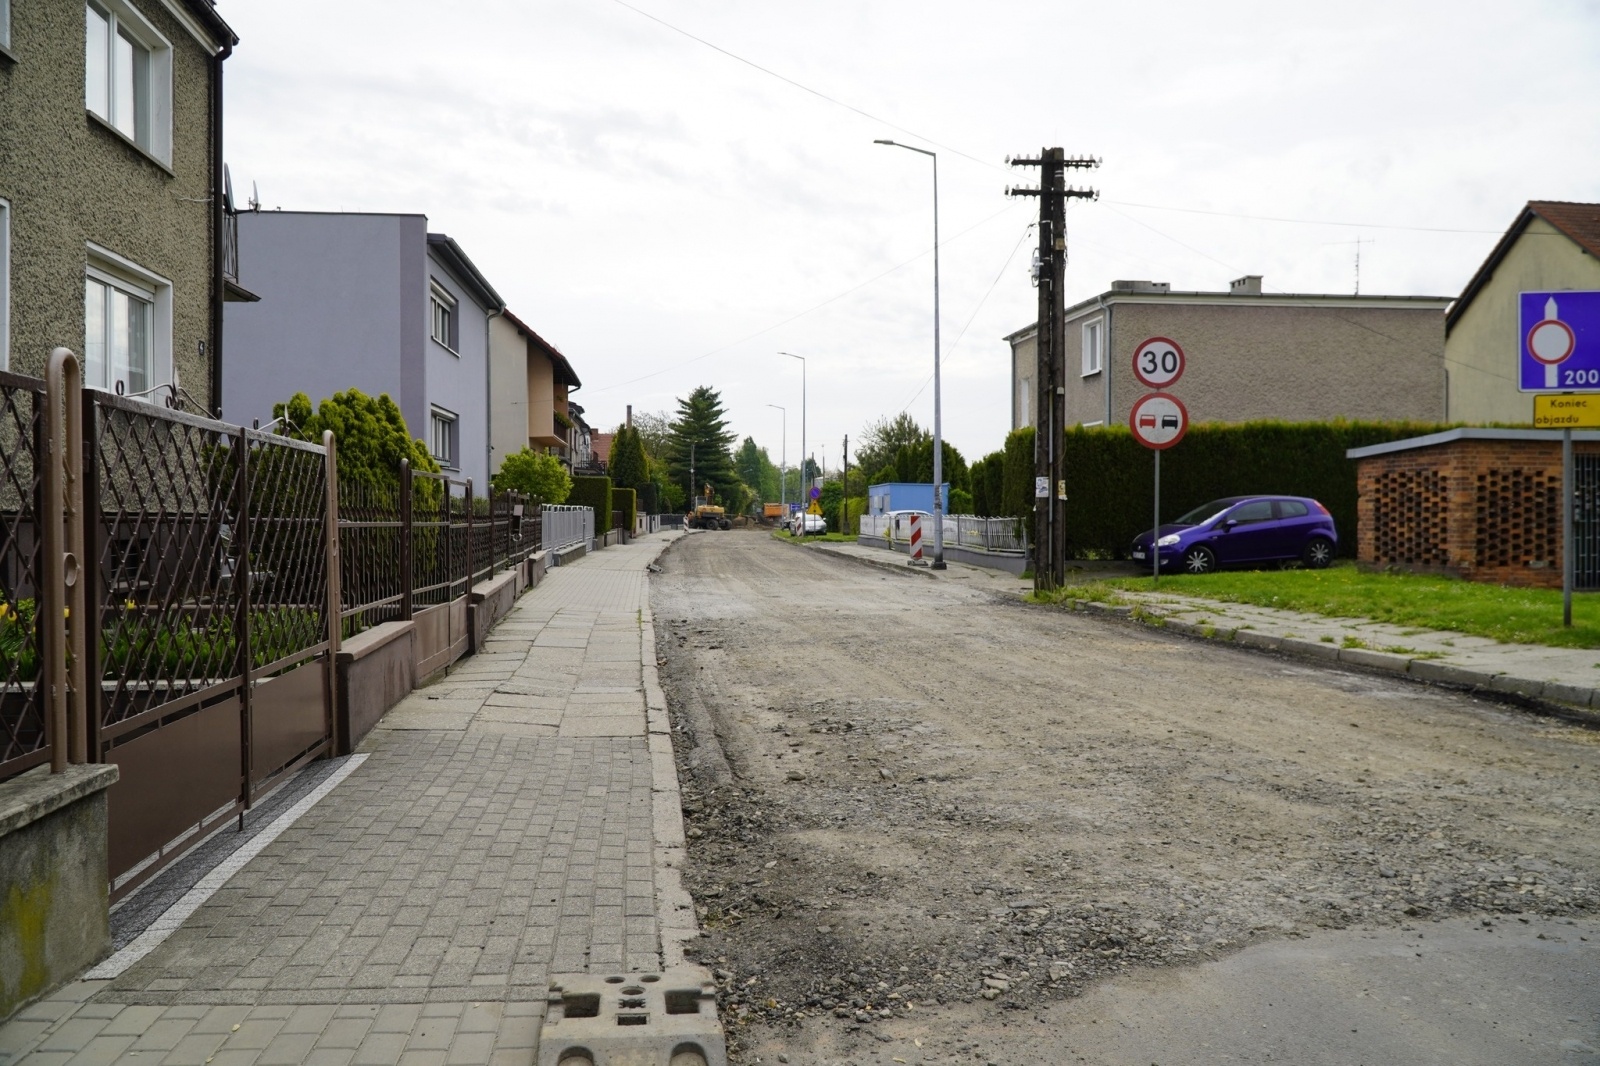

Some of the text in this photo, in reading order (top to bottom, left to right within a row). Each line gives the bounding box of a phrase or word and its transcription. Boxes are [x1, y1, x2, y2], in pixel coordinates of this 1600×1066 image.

[1142, 351, 1178, 374] 30
[1564, 369, 1600, 385] 200
[1550, 399, 1588, 408] Koniec
[1535, 415, 1580, 426] objazdu
